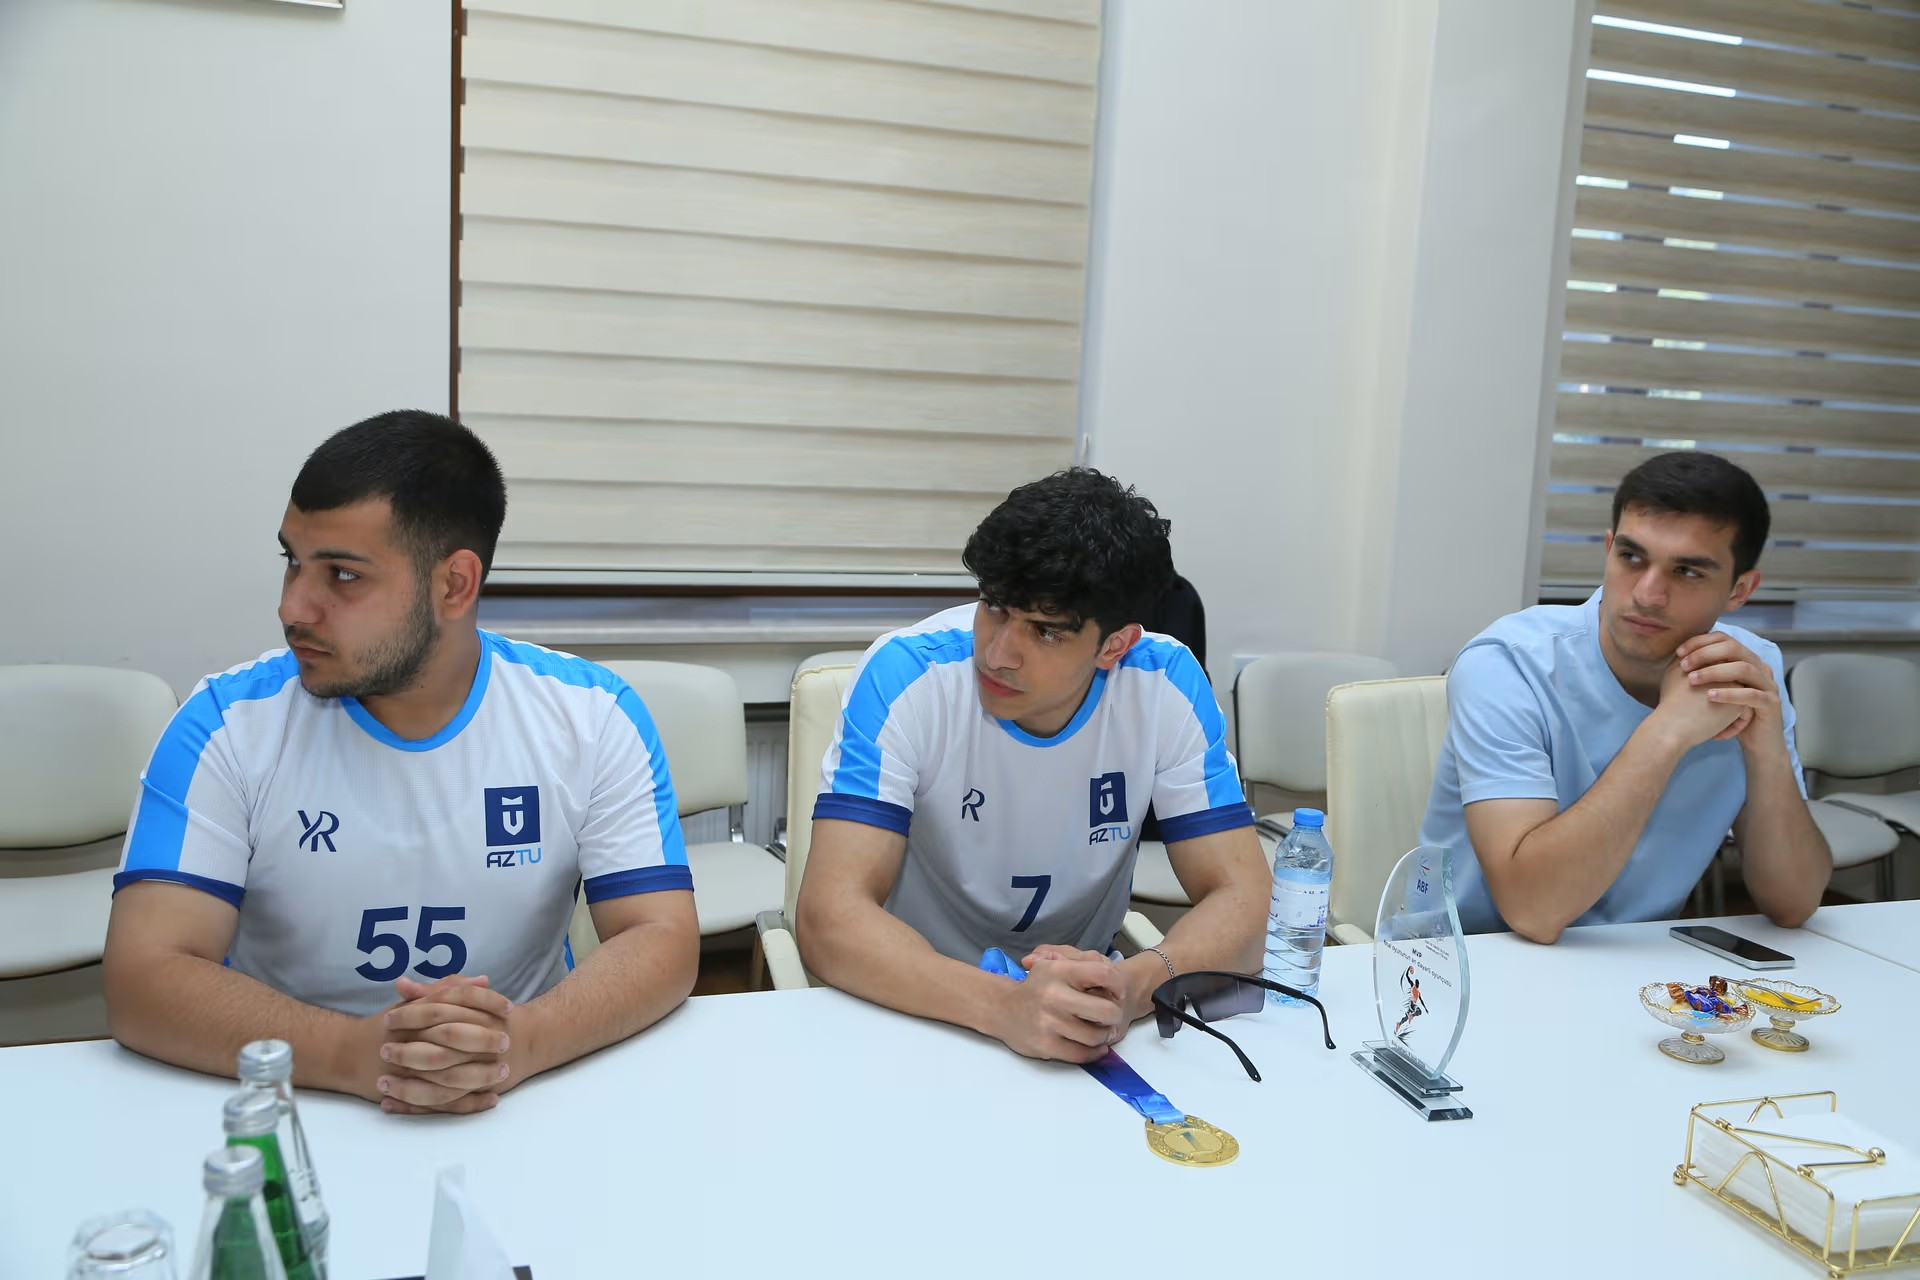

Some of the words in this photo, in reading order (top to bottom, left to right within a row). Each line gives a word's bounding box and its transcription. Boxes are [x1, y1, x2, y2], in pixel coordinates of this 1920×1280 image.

[1089, 826, 1131, 845] AZTU
[486, 847, 542, 868] AZTU
[1011, 875, 1051, 932] 7
[354, 906, 468, 982] 55
